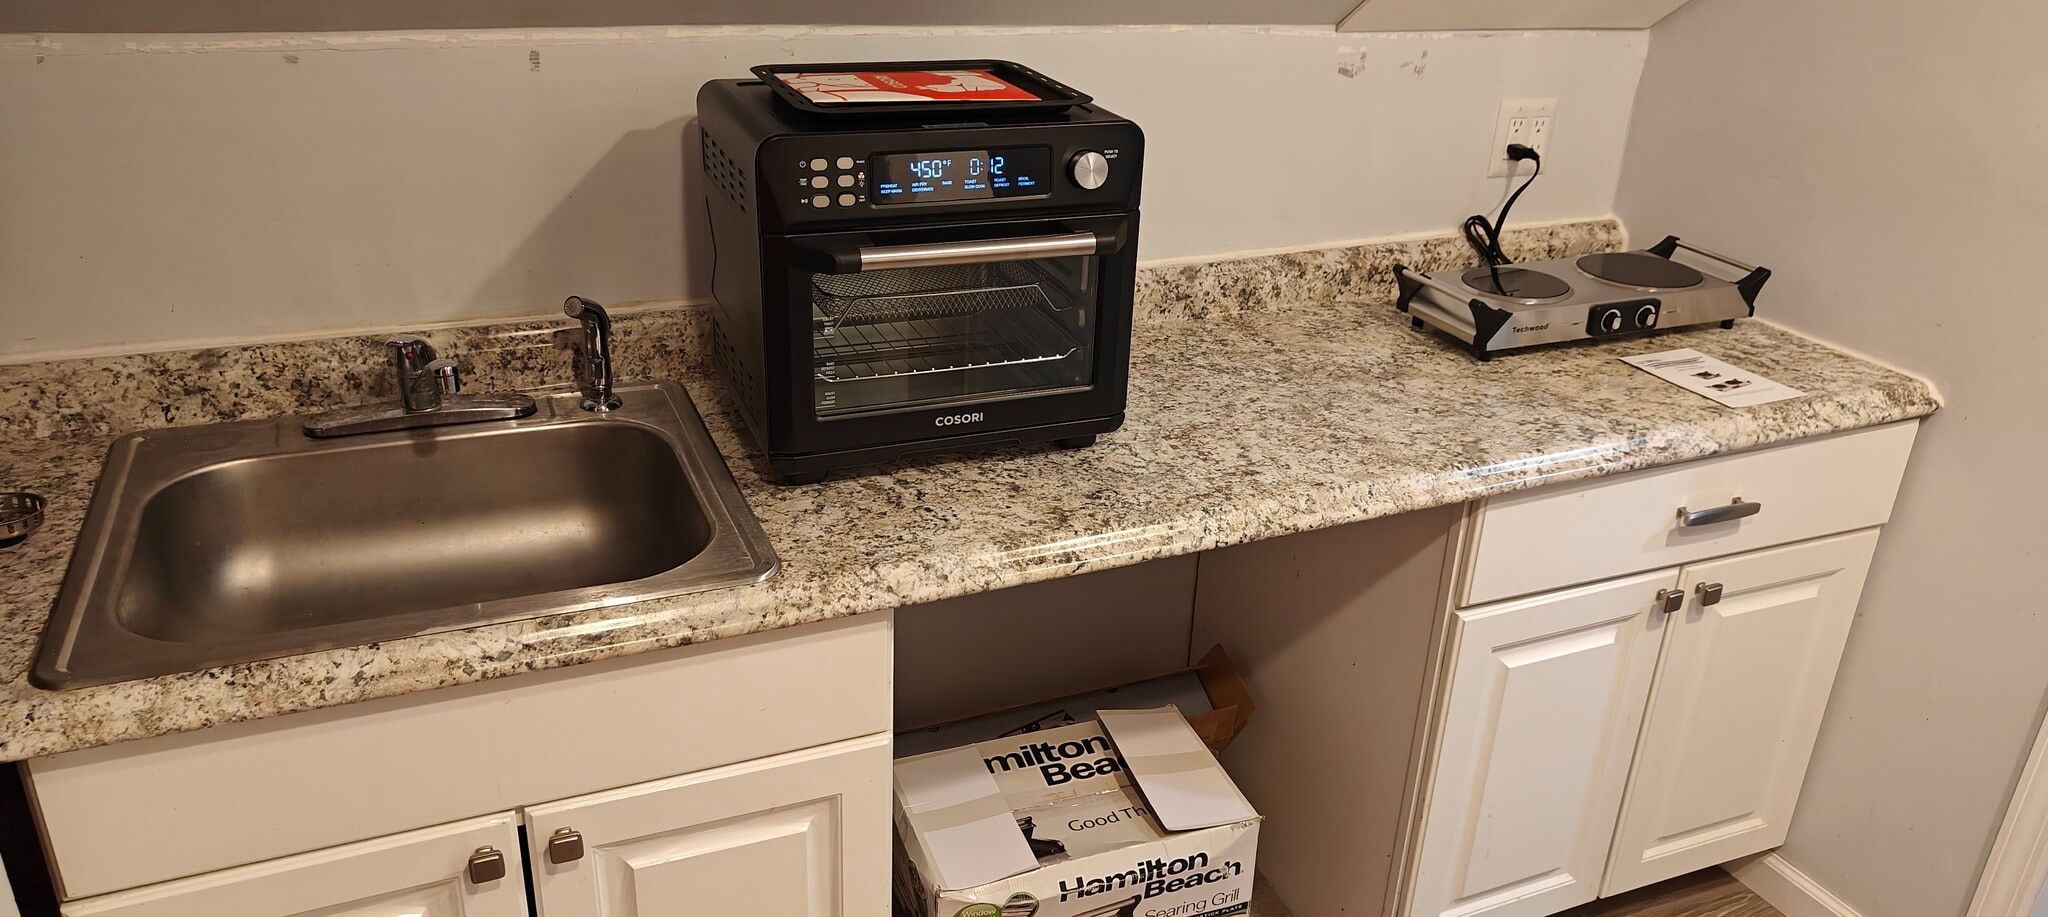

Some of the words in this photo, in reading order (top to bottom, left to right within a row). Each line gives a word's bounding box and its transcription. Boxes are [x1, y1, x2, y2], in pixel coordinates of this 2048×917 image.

[969, 156, 1004, 176] 0:12
[1512, 323, 1550, 334] Techwood
[935, 412, 984, 427] COSORI
[1067, 811, 1121, 832] Good
[1058, 852, 1208, 903] Hamilton
[1143, 861, 1242, 900] Beach
[962, 908, 997, 917] Window
[1144, 899, 1208, 917] Searing
[1211, 888, 1240, 906] Grill
[1221, 904, 1243, 914] PLATE
